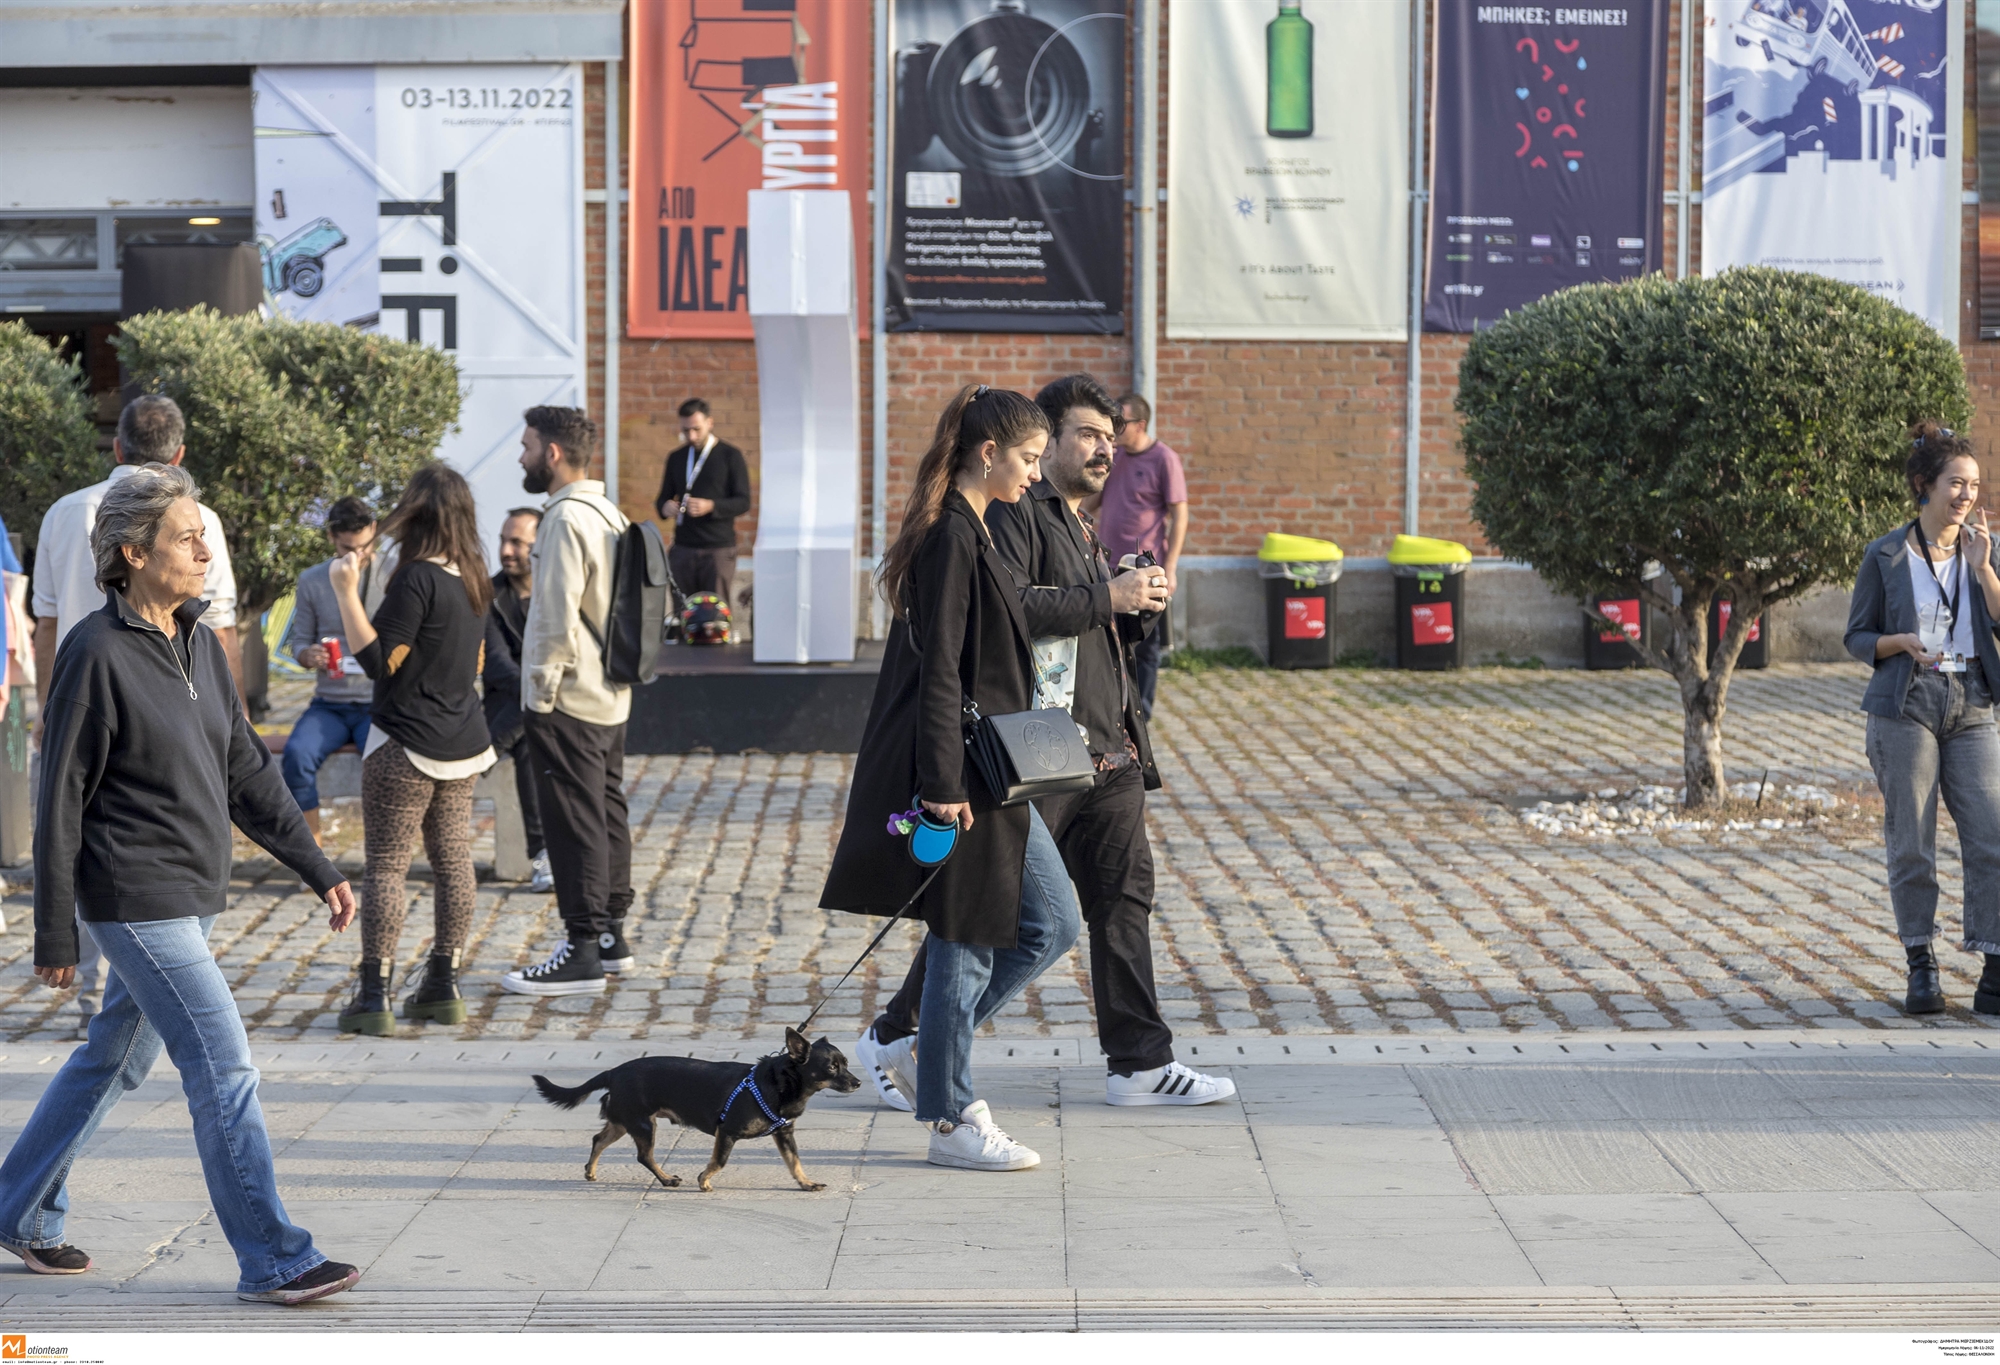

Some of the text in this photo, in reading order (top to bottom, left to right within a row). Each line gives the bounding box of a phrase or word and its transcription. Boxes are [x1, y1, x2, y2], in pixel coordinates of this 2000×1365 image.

[1478, 6, 1628, 26] ΜΠΗΚΕΣ; ΕΜΕΙΝΕΣ!
[401, 87, 573, 109] 03-13.11.2022
[658, 187, 696, 219] ΑΠΟ
